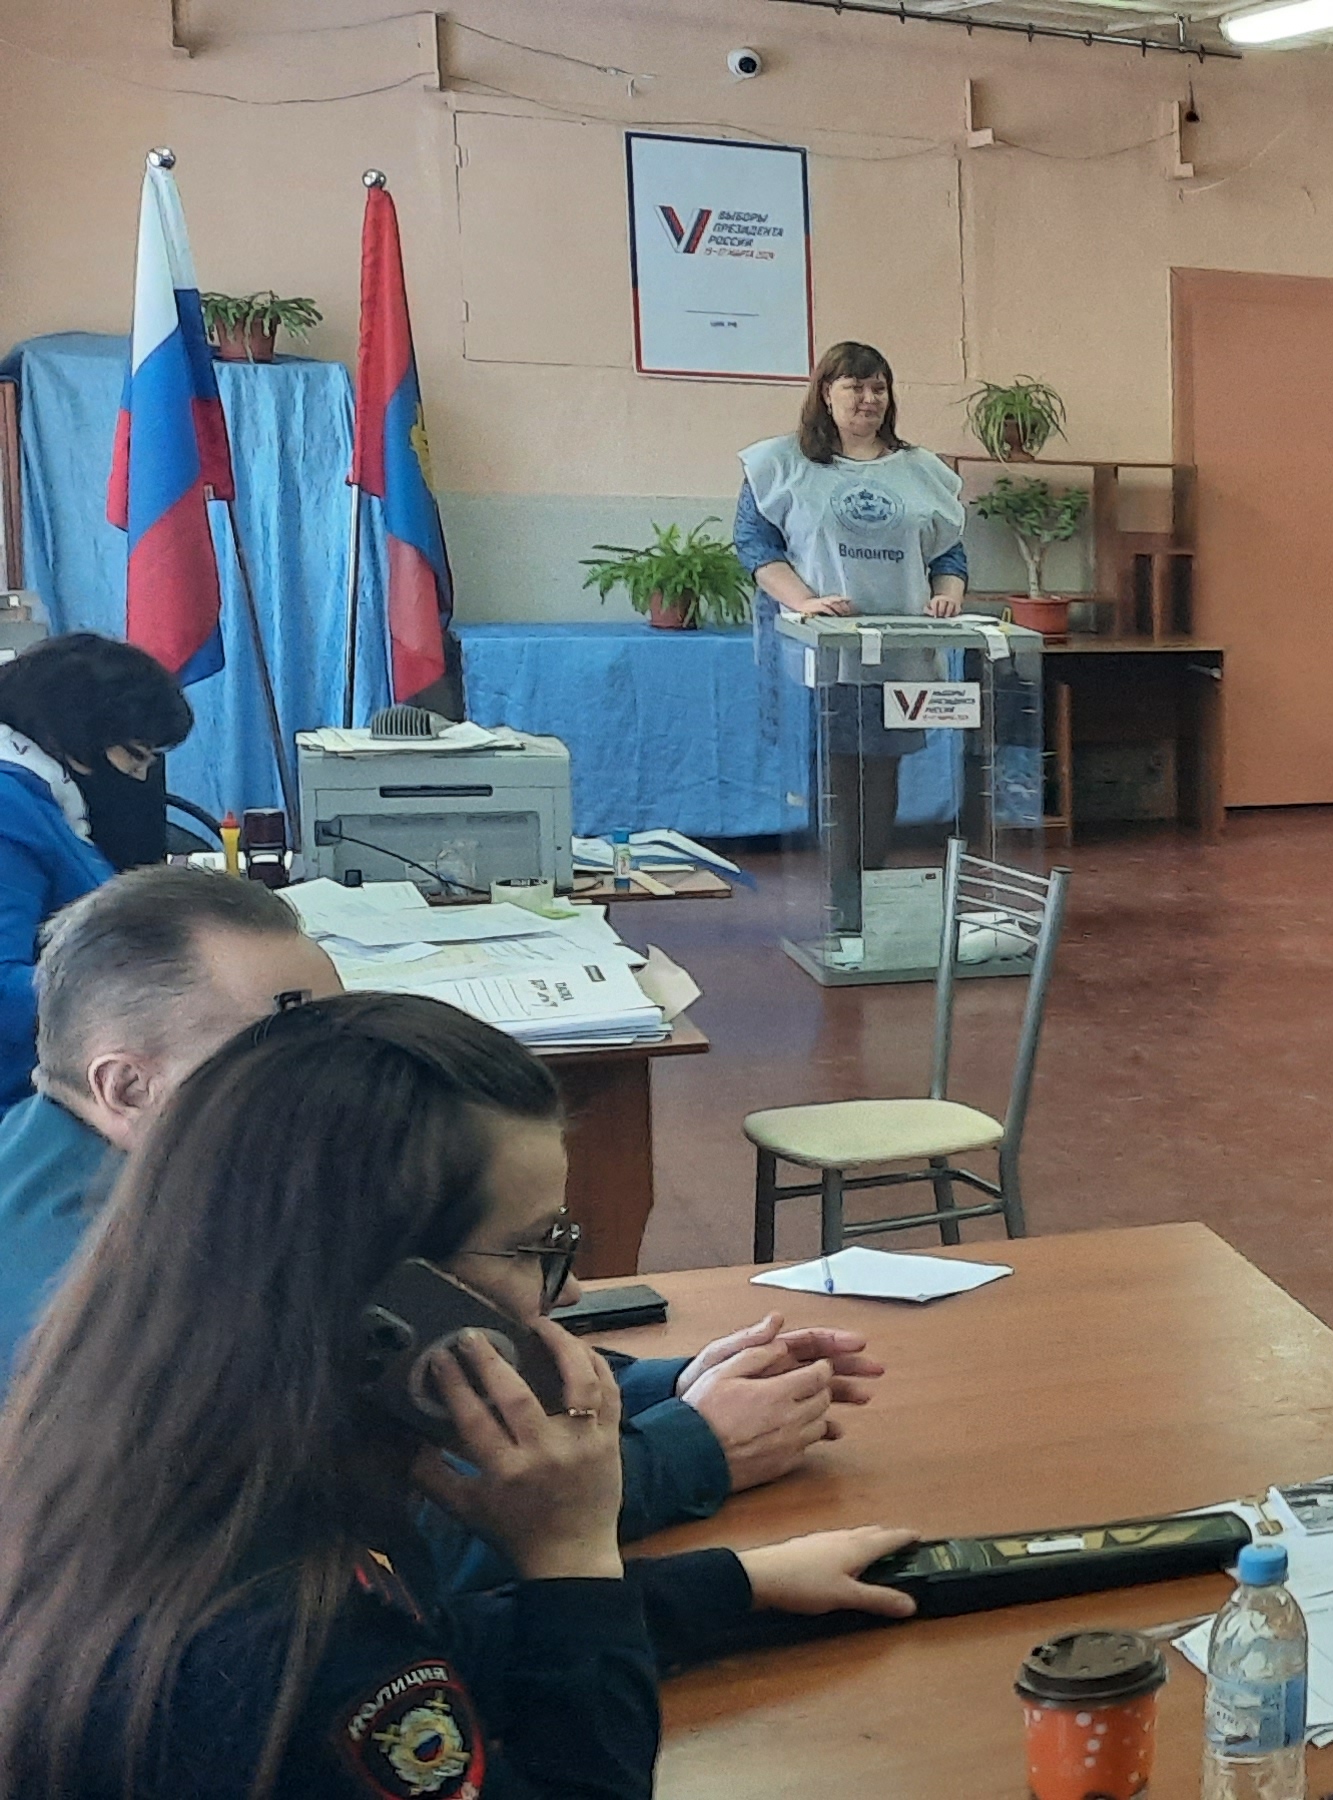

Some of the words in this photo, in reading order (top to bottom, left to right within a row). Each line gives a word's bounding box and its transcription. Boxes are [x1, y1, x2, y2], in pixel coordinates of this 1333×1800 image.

[718, 210, 768, 222] ВЫБОРЫ
[713, 223, 784, 237] ПРЕЗИДЕНТА
[708, 235, 753, 246] РОССИИ
[839, 543, 904, 563] Волонтер
[348, 1666, 449, 1742] ПОЛИЦИЯ
